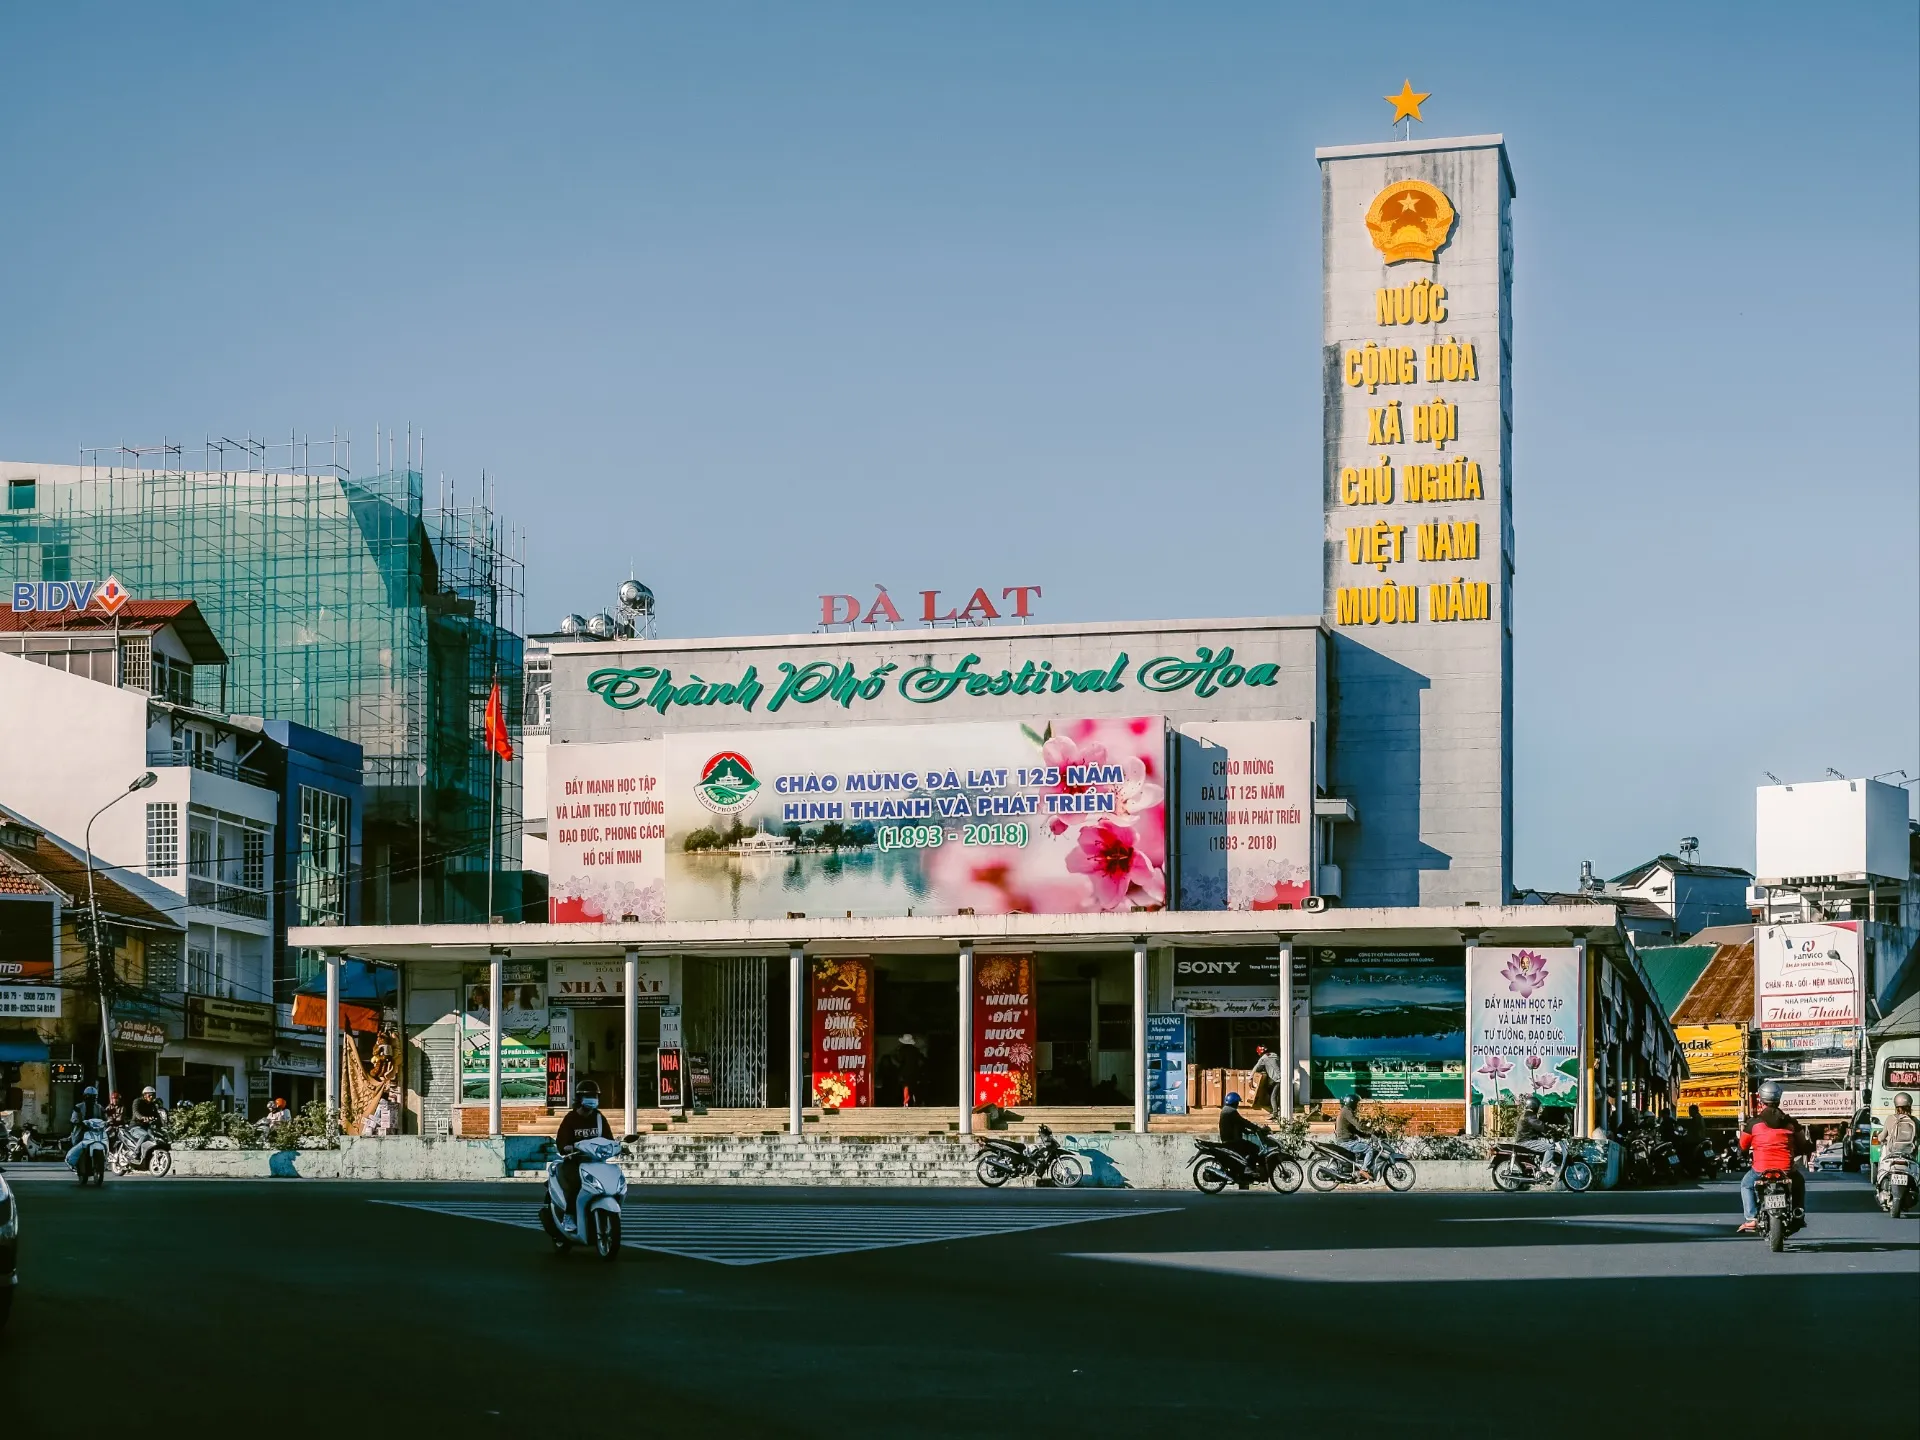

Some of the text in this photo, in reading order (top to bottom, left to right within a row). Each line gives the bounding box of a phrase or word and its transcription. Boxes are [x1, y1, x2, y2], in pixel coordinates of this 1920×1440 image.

[1375, 277, 1446, 326] NƯỚC
[1345, 335, 1476, 394] CỘNG HÒA
[1367, 395, 1455, 450] XÃ HỘI
[1341, 454, 1482, 505] CHỦ NGHĨA
[1345, 520, 1477, 571] VIỆT NAM
[11, 580, 95, 612] BIDV
[818, 584, 904, 625] ĐÀ
[1336, 576, 1489, 625] MUÔN NĂM
[587, 646, 1281, 716] Thành Phố Festival Hoa
[1212, 758, 1240, 776] CHÀO
[586, 779, 614, 796] MẠNH
[617, 778, 636, 795] HỌC
[639, 775, 656, 794] TẬP
[775, 763, 1124, 794] CHÀO MỪNG ĐÀ LẠT 125 NĂM
[1240, 786, 1258, 800] 125
[1261, 782, 1284, 800] NĂM
[556, 796, 664, 819] VÀ LÀM THEO TƯ TƯỞNG
[784, 788, 1115, 821] HÌNH THÀNH VÀ PHÁT TRIỂN
[1185, 804, 1301, 826] HÌNH THÀNH VÀ PHÁT TRIỂN
[559, 822, 665, 846] ĐẠO ĐỨC, PHONG CÁCH
[879, 826, 943, 852] (1893
[964, 823, 1029, 847] 2018)
[1210, 836, 1238, 852] (1893
[1248, 835, 1277, 851] 2018)
[598, 848, 614, 866] CHÍ
[616, 850, 642, 865] MINH
[1177, 961, 1240, 974] SONY
[558, 976, 607, 994] NHÀ
[1503, 998, 1526, 1012] MẠNH
[1528, 998, 1545, 1012] HỌC
[1548, 997, 1563, 1012] TẬP
[1499, 1012, 1552, 1024] VÀ LÀM THEO
[822, 1036, 862, 1052] QUANG
[1484, 1028, 1495, 1040] TƯ
[1680, 1040, 1712, 1050] odak
[661, 1050, 678, 1070] NHÀ
[1473, 1045, 1500, 1056] PHONG
[1502, 1043, 1524, 1056] CÁCH
[1556, 1046, 1577, 1056] MINH
[549, 1053, 566, 1072] NHÀ
[548, 1073, 566, 1095] ĐẤT
